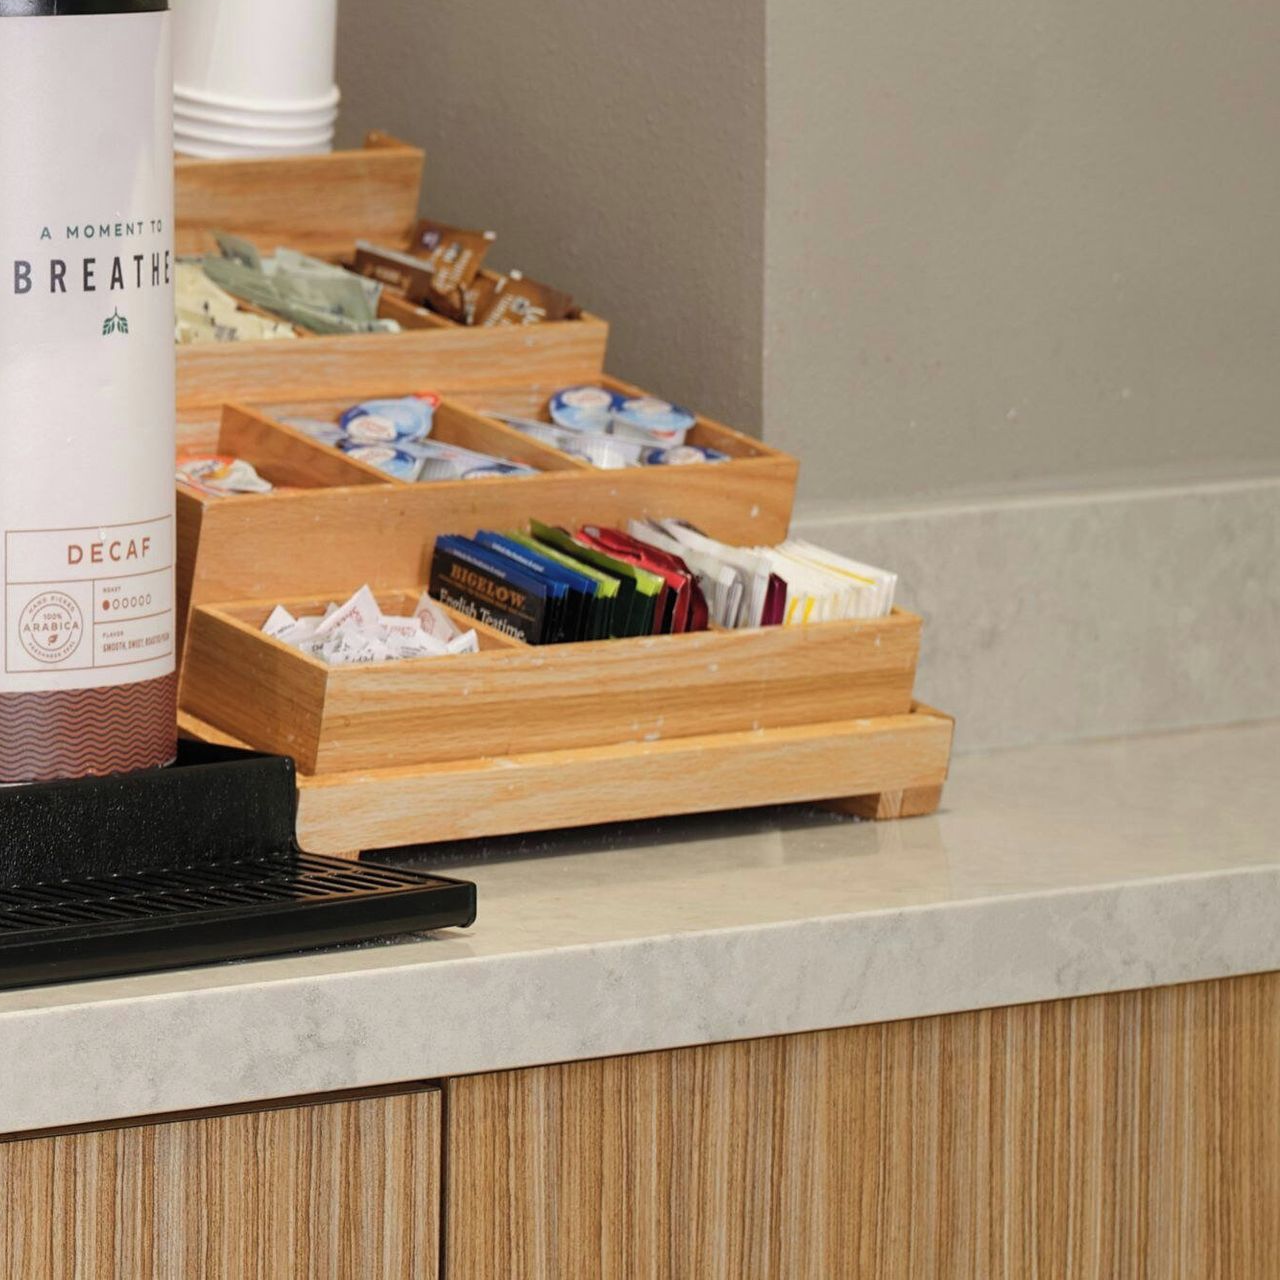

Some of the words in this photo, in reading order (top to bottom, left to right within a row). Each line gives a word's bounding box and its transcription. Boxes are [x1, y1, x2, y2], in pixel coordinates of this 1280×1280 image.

[40, 226, 52, 240] A
[66, 221, 144, 239] MOMENT
[150, 219, 162, 233] TO
[13, 250, 170, 295] BREATHE
[67, 536, 151, 565] DECAF
[450, 563, 527, 608] BIGELOW
[23, 621, 80, 633] ARABICA
